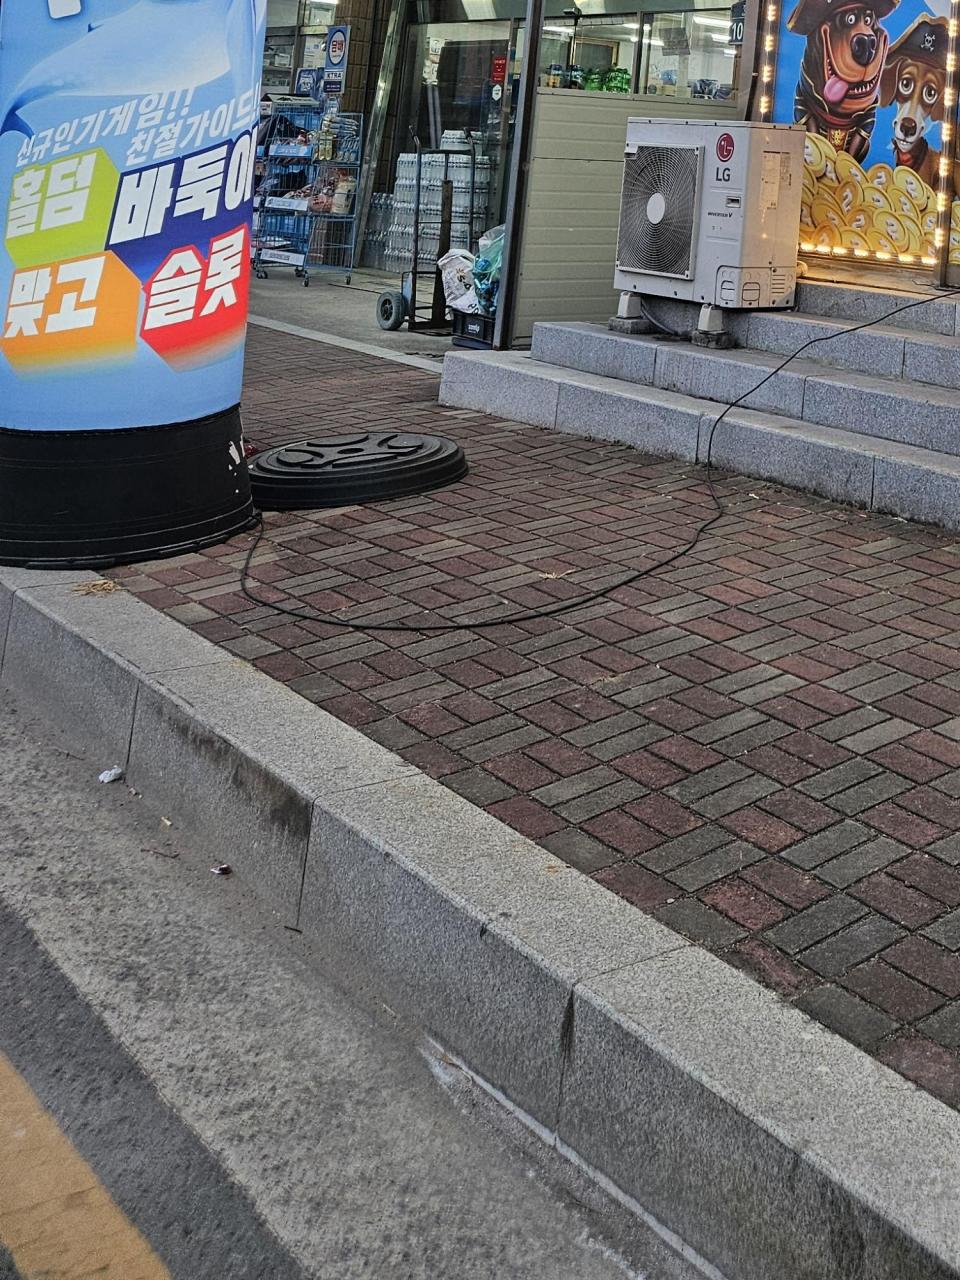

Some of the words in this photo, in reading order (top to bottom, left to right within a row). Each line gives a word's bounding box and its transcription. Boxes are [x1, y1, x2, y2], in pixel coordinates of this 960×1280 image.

[6, 152, 97, 238] 홀덤
[109, 125, 259, 245] 바둑이
[715, 167, 731, 182] LG
[4, 256, 106, 338] 맞고
[144, 228, 247, 330] 슬롯
